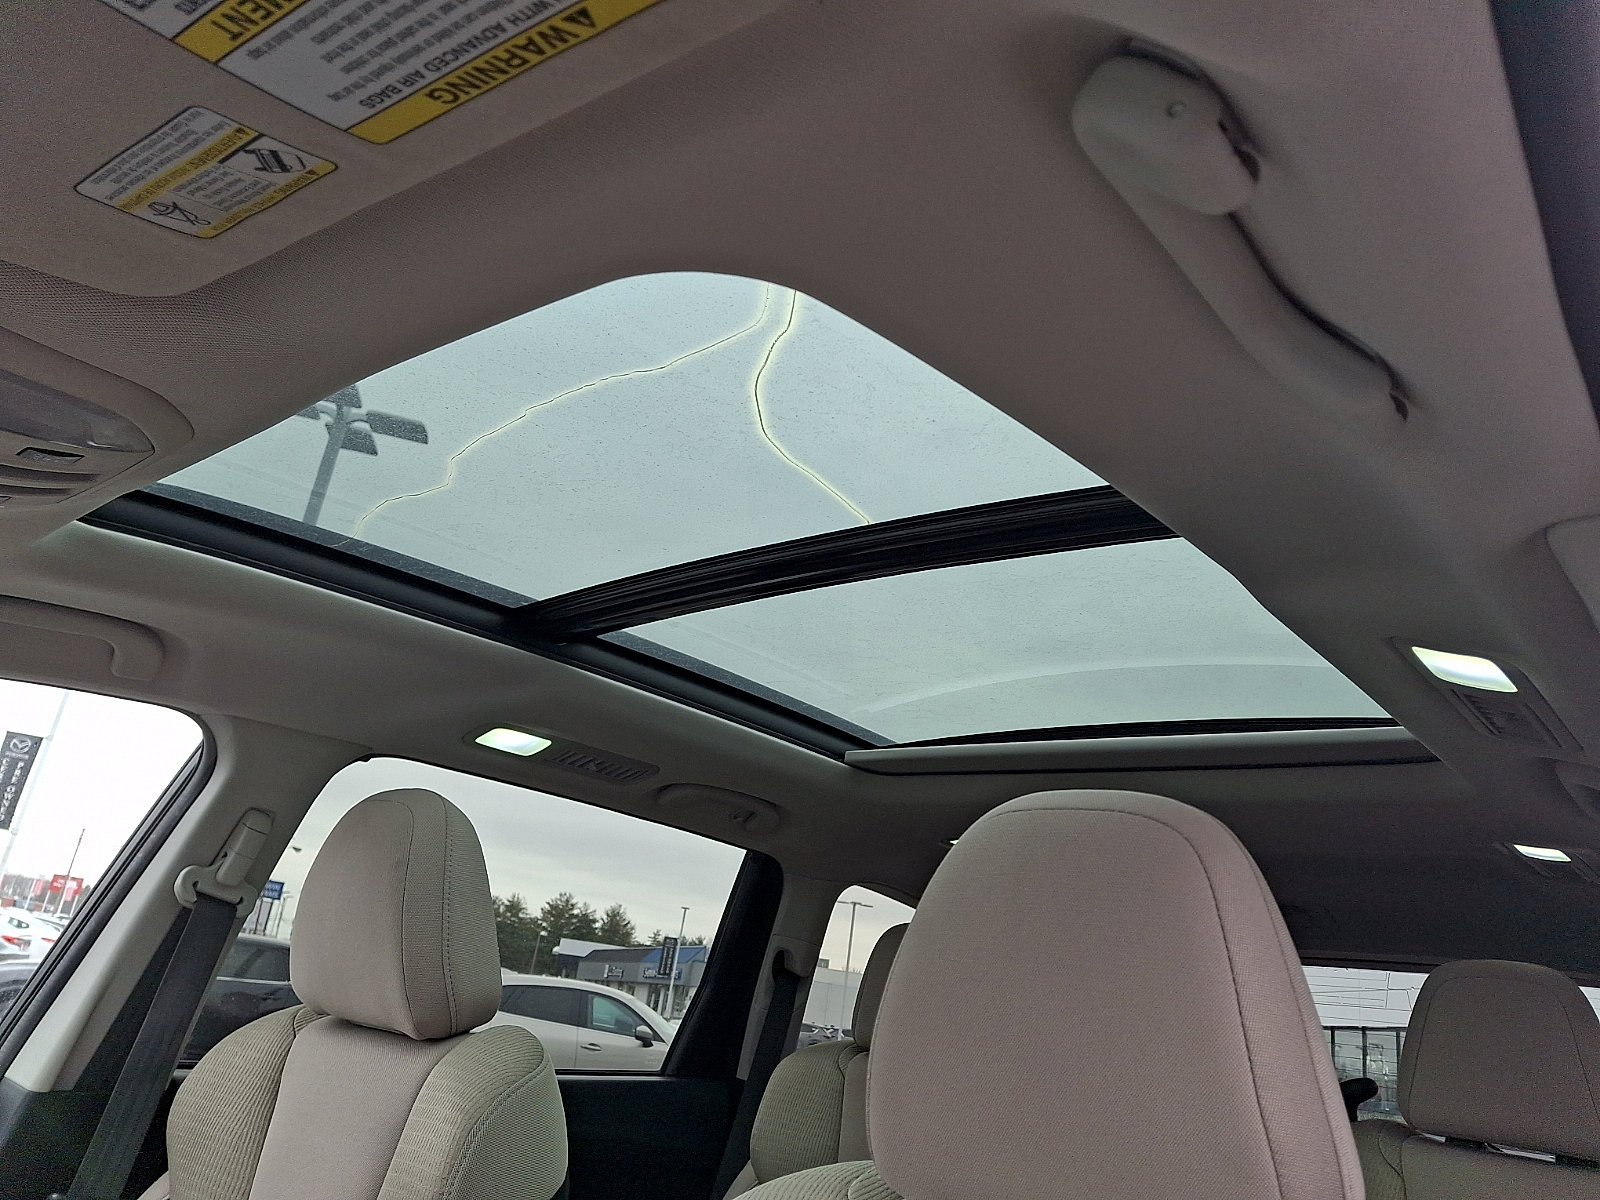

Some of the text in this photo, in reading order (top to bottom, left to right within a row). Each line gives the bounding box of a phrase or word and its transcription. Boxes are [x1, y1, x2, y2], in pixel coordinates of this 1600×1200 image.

[424, 22, 507, 72] ADVANCED
[425, 25, 580, 104] WARNING
[359, 84, 402, 109] BAGS
[397, 70, 425, 87] AIR
